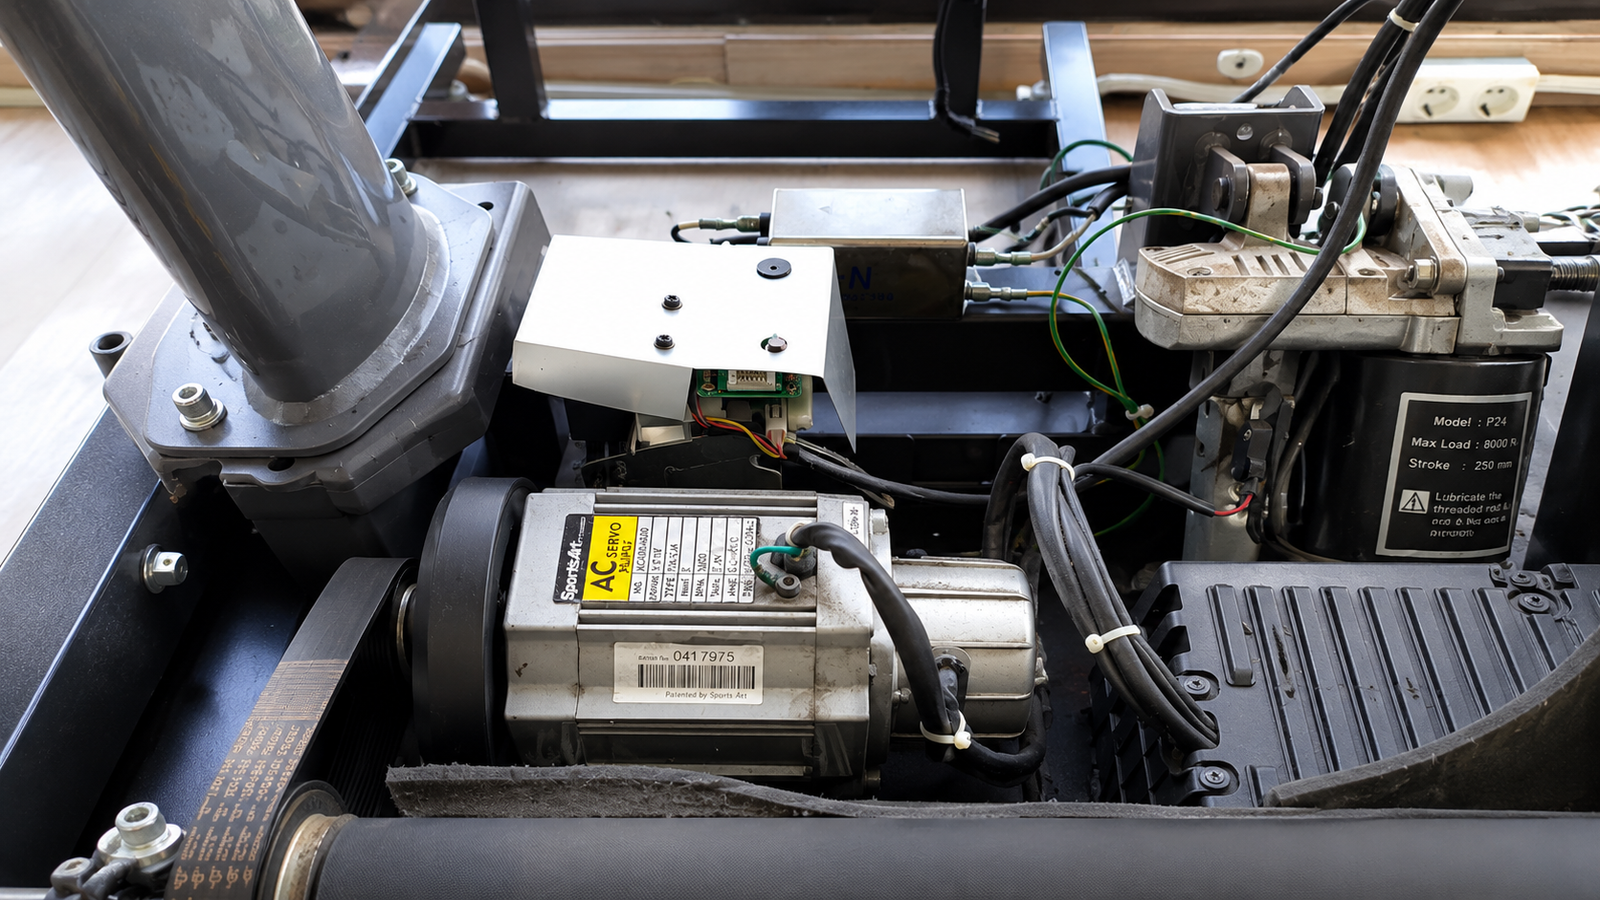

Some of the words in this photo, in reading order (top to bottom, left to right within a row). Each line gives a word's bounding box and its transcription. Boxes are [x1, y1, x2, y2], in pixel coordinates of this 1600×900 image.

[1486, 416, 1507, 427] P24
[1411, 437, 1437, 448] Max
[1441, 439, 1471, 449] Load
[1483, 439, 1508, 449] 8000
[1408, 458, 1450, 470] Stroke
[1474, 461, 1494, 470] 250
[1435, 492, 1486, 501] Lubricate
[1433, 505, 1483, 514] threaded
[590, 561, 617, 593] AC
[606, 522, 622, 558] SERVO
[699, 692, 708, 700] by
